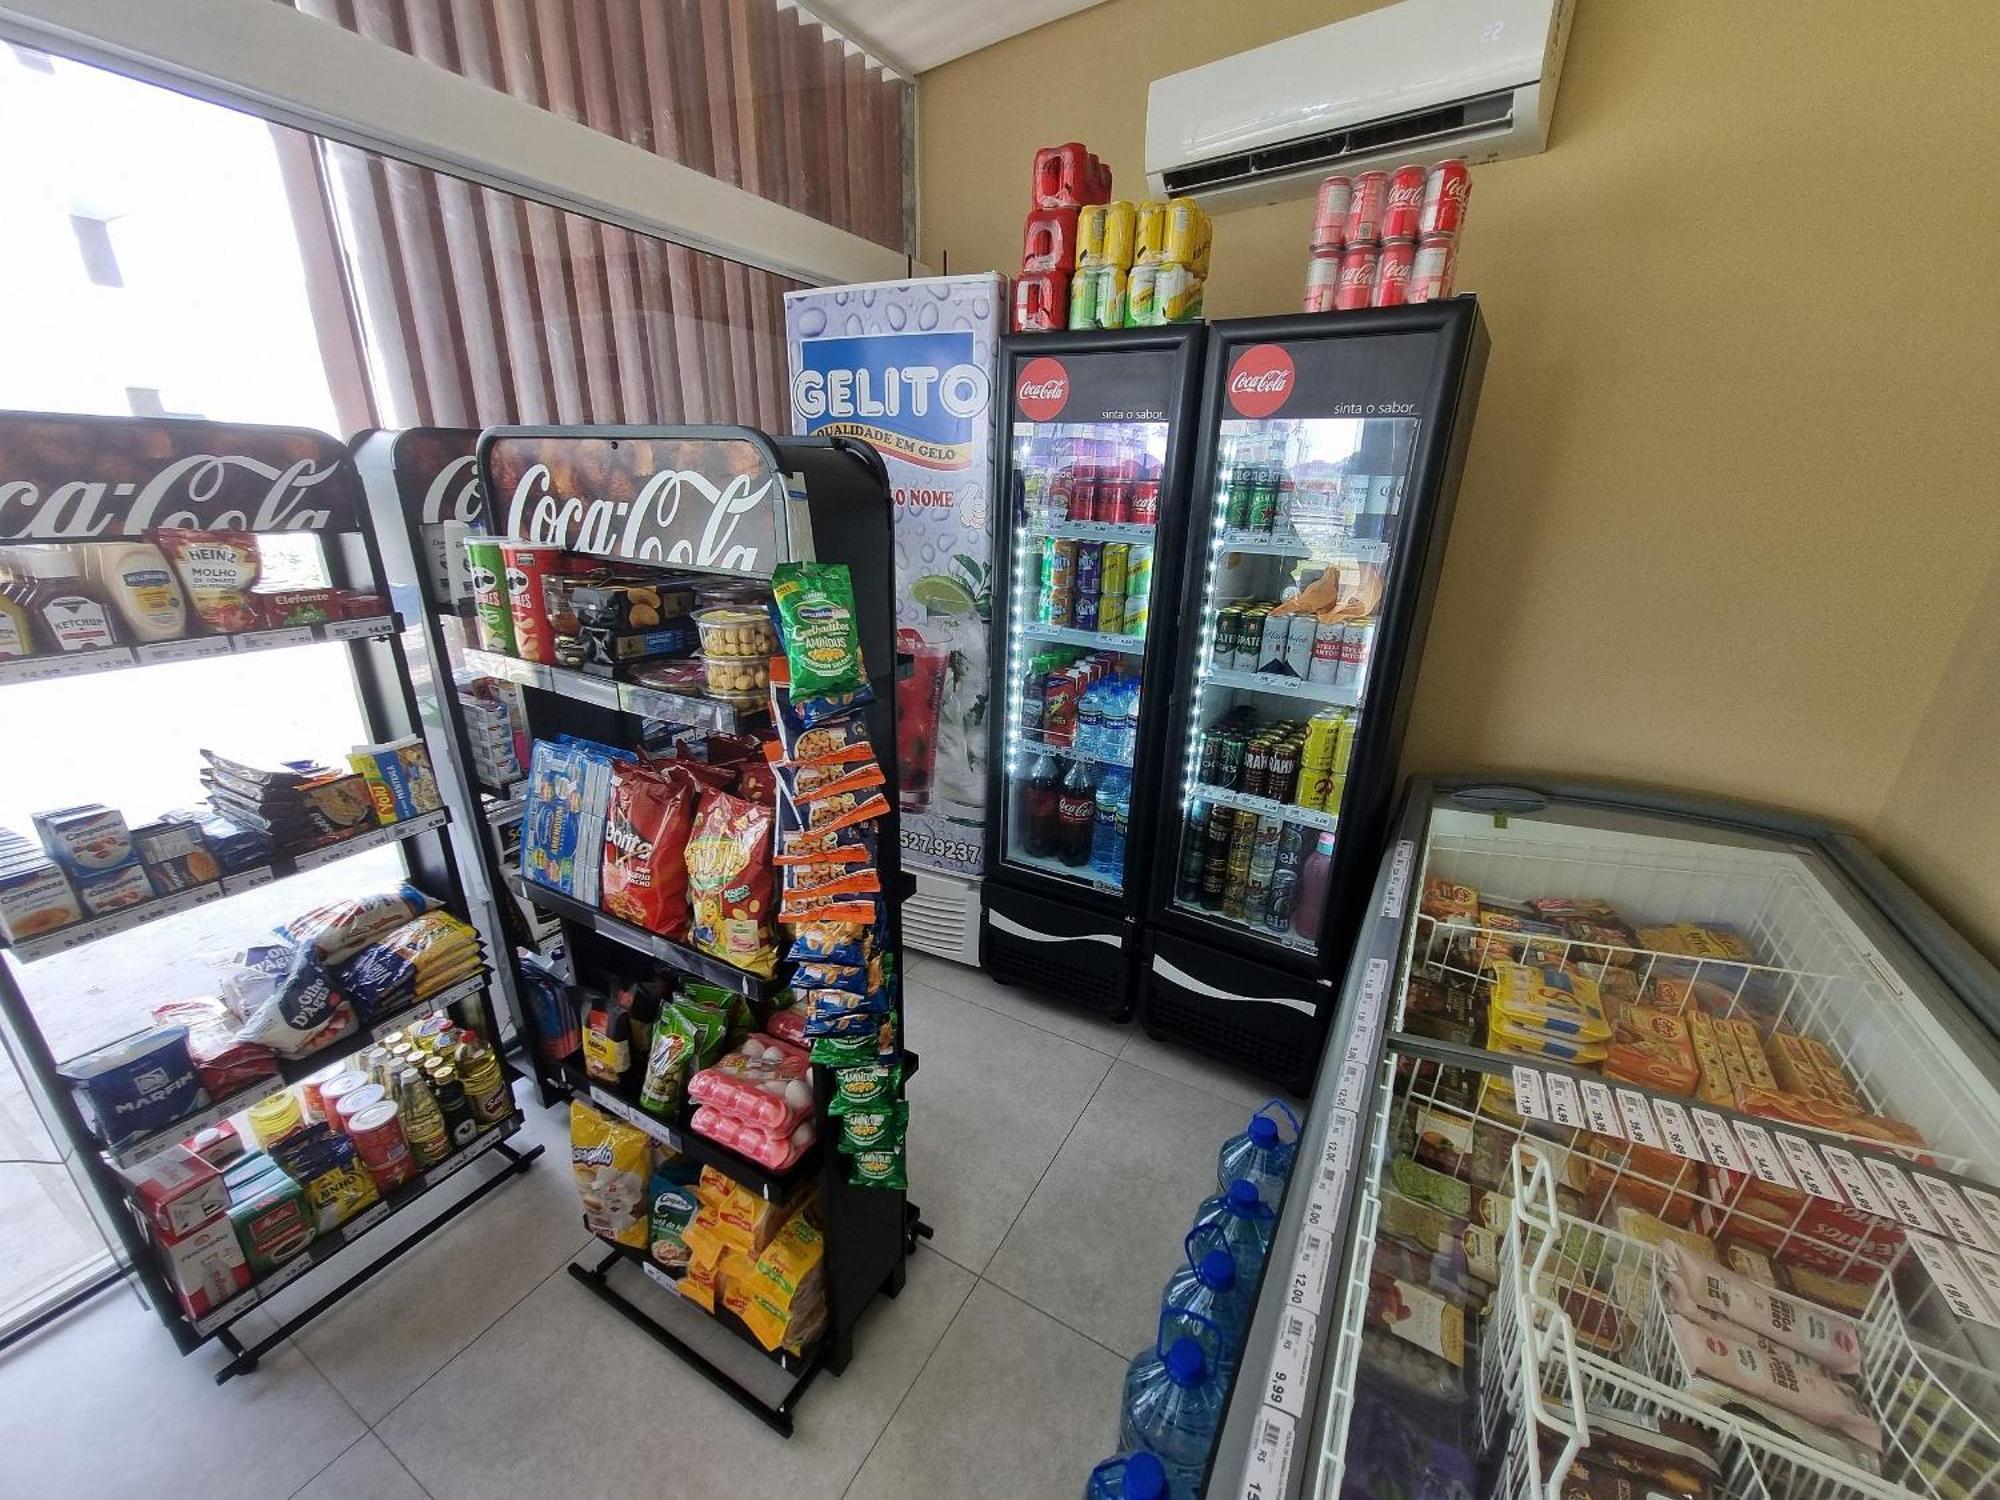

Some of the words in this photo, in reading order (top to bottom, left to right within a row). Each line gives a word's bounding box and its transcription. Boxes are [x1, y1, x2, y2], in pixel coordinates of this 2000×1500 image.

[792, 363, 991, 419] GELITO
[1019, 379, 1068, 400] Coca-Cola
[1232, 369, 1290, 393] Coca-Cola
[1102, 409, 1124, 420] sinta
[1126, 411, 1133, 419] o
[1135, 409, 1164, 420] sabor
[1334, 402, 1362, 415] sinta
[1366, 404, 1375, 414] o
[1378, 401, 1415, 414] sabor
[817, 422, 892, 445] QUALIDADE
[896, 436, 915, 453] EM
[918, 444, 956, 461] GELO
[0, 455, 341, 540] ca-Cola
[910, 490, 954, 507] NOME
[508, 464, 773, 572] Coca-Cola
[189, 549, 237, 563] HEINZ
[192, 567, 236, 577] MOLHO
[275, 592, 328, 605] Elefante
[54, 617, 104, 630] KETCHUP
[300, 978, 325, 1006] Olho
[1521, 1095, 1533, 1115] 11,99
[1556, 1103, 1569, 1123] 14,99
[1592, 1111, 1608, 1132] 39,99
[1291, 1273, 1307, 1304] 12,00
[1270, 1371, 1287, 1404] 9,99
